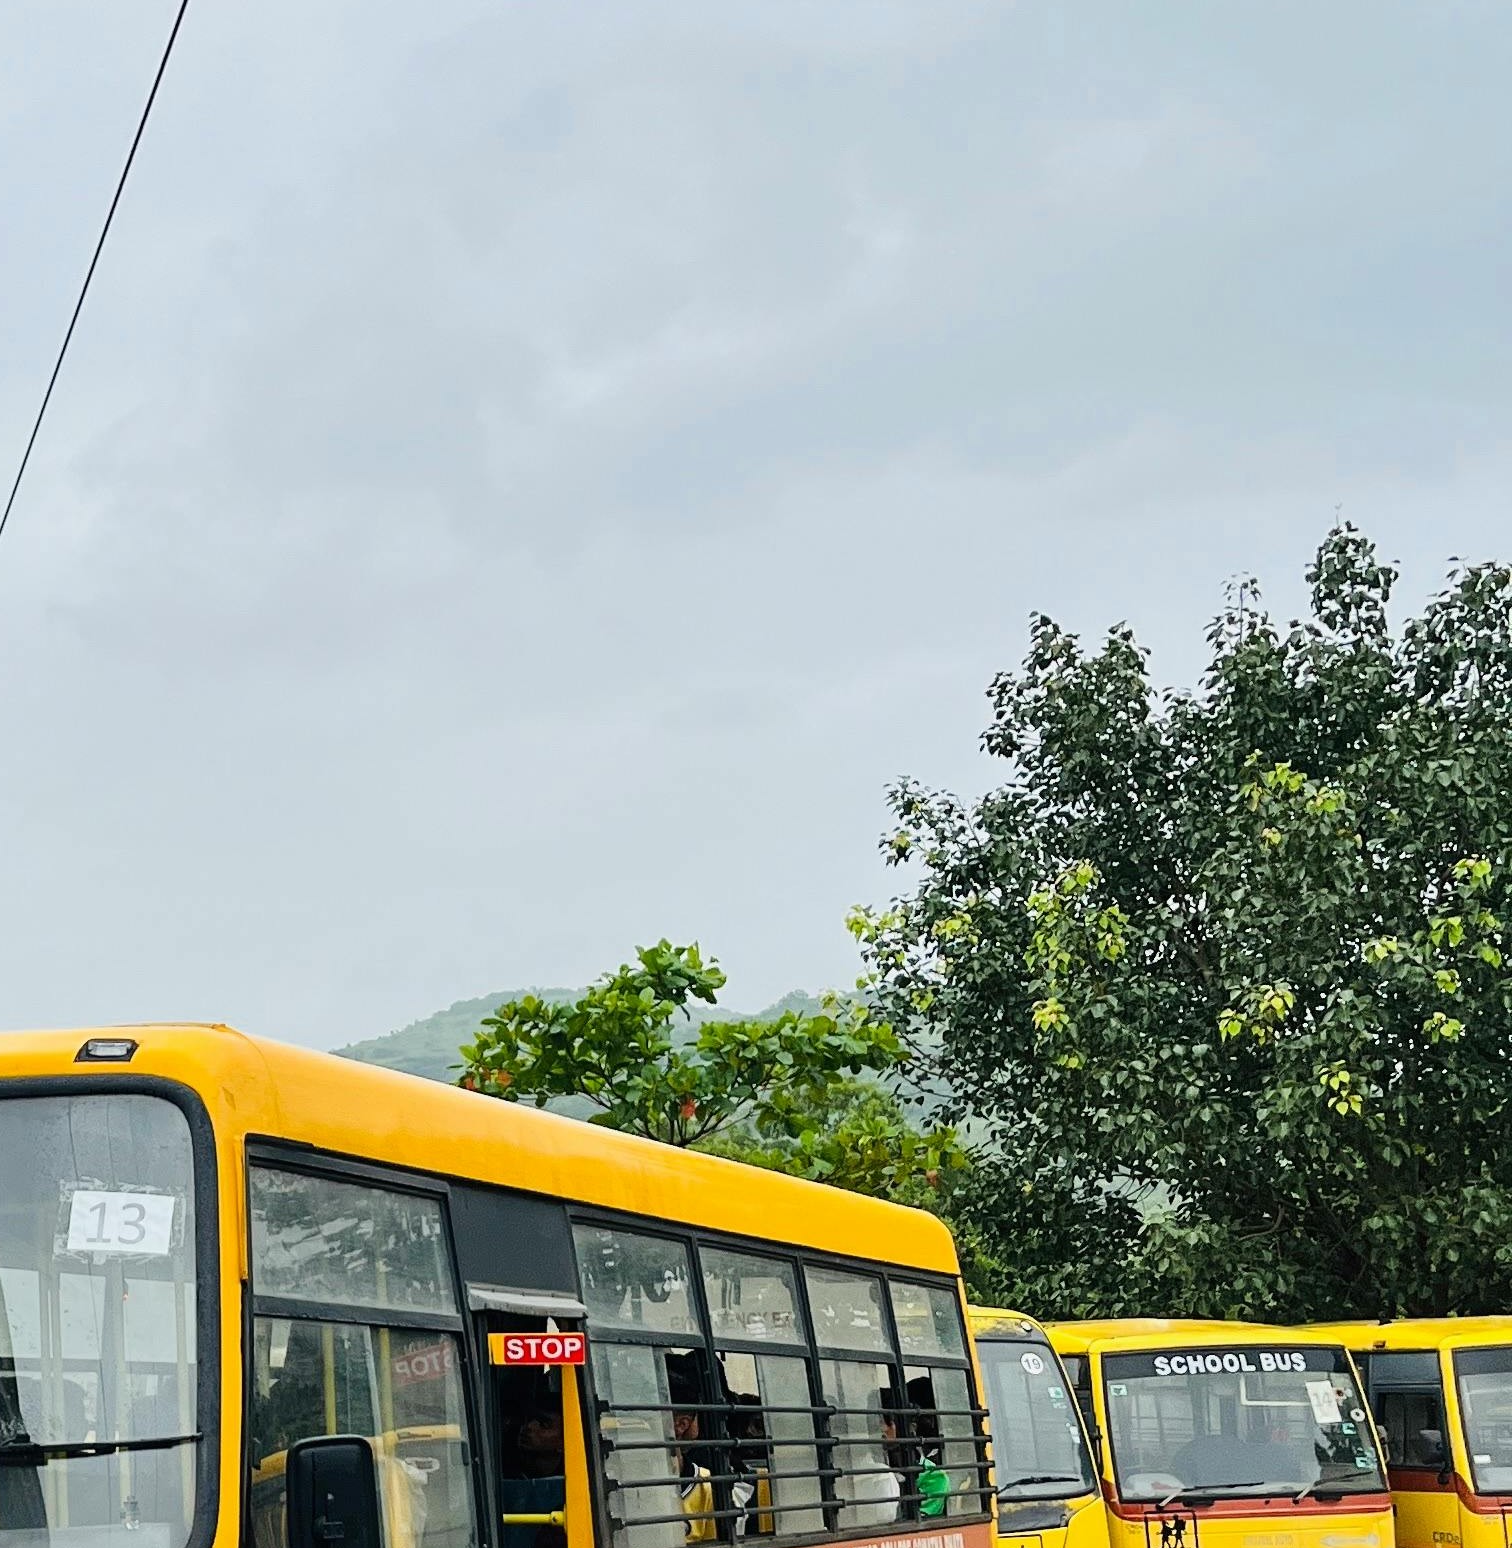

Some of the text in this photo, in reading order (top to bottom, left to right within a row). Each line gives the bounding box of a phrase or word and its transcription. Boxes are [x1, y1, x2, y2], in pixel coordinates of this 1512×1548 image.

[85, 1200, 147, 1246] 13
[506, 1337, 582, 1360] STOP
[1022, 1358, 1041, 1370] 19
[1153, 1352, 1307, 1376] SCHOOL BUS
